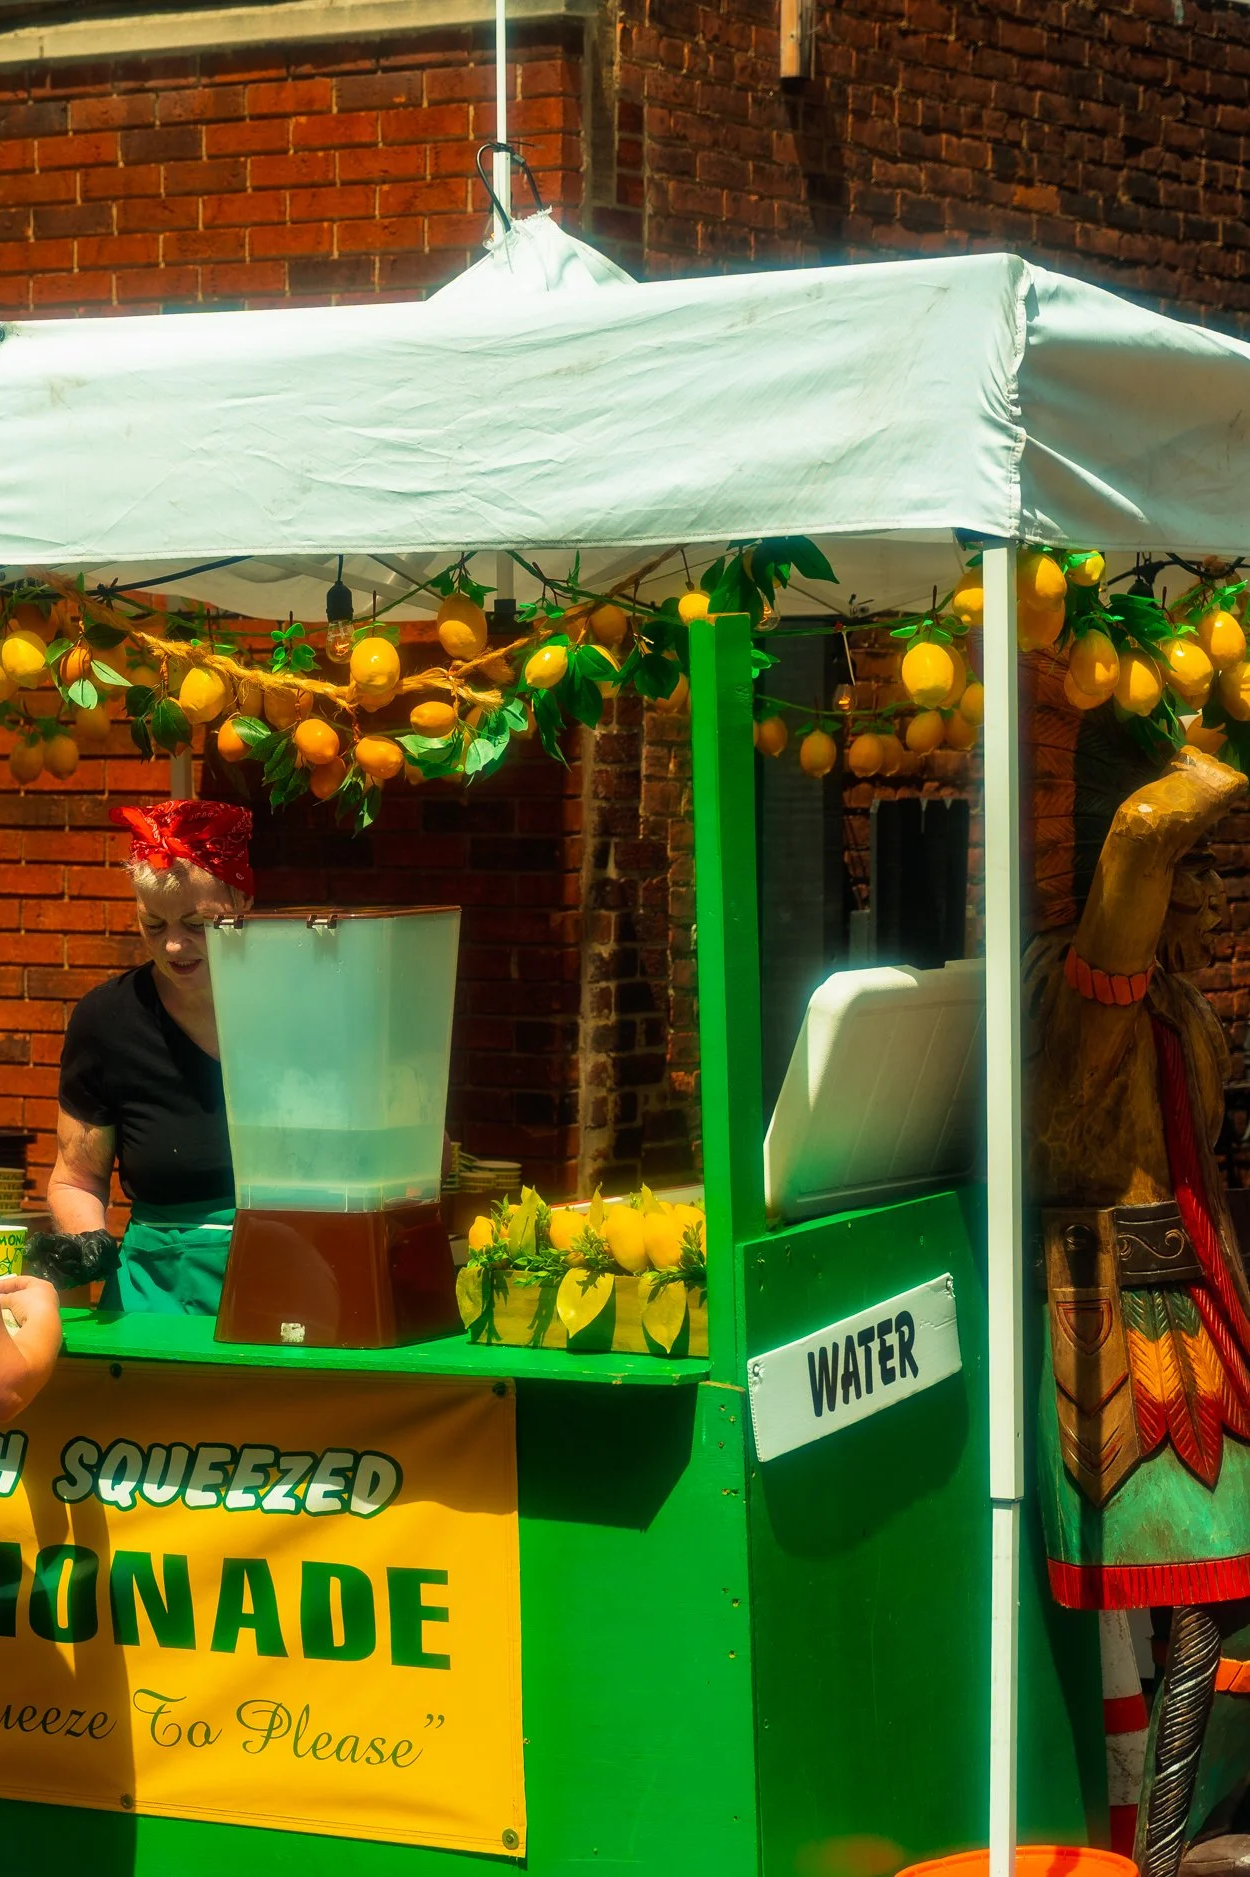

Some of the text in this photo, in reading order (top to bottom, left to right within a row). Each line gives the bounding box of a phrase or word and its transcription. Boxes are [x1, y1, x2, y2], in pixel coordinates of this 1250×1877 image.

[808, 1311, 919, 1418] WATER
[54, 1436, 403, 1519] SQUEEZED
[132, 1688, 223, 1748] To
